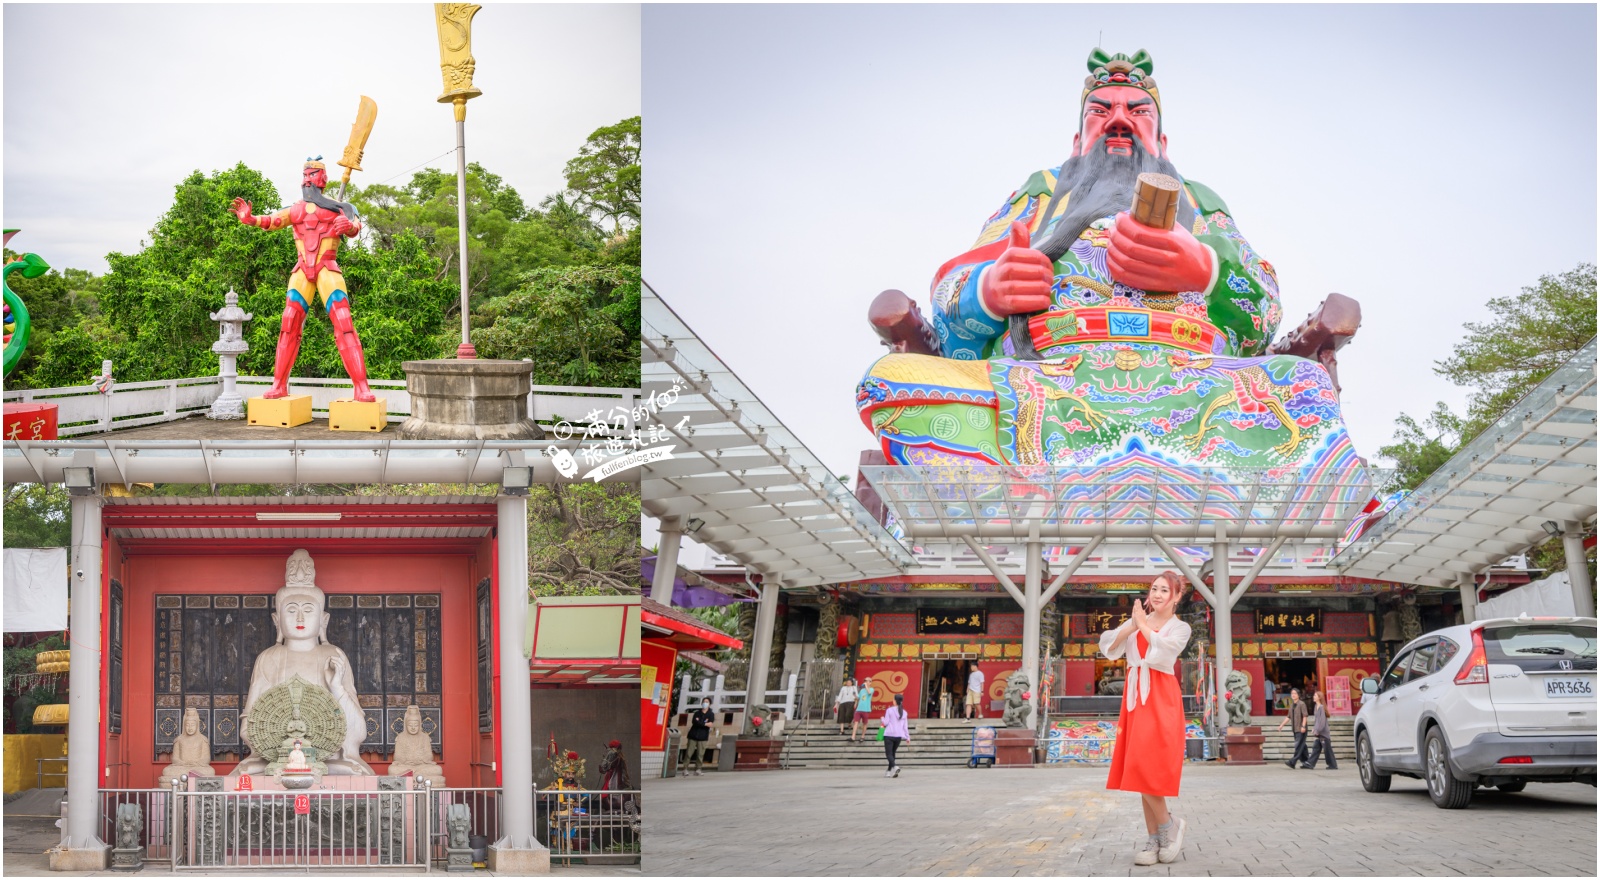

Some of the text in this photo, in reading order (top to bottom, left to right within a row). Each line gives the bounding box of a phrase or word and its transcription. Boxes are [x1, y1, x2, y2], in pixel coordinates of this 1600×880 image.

[7, 417, 46, 440] 天宮
[1547, 681, 1592, 694] APR-3636
[241, 776, 250, 785] 13
[297, 798, 307, 808] 12
